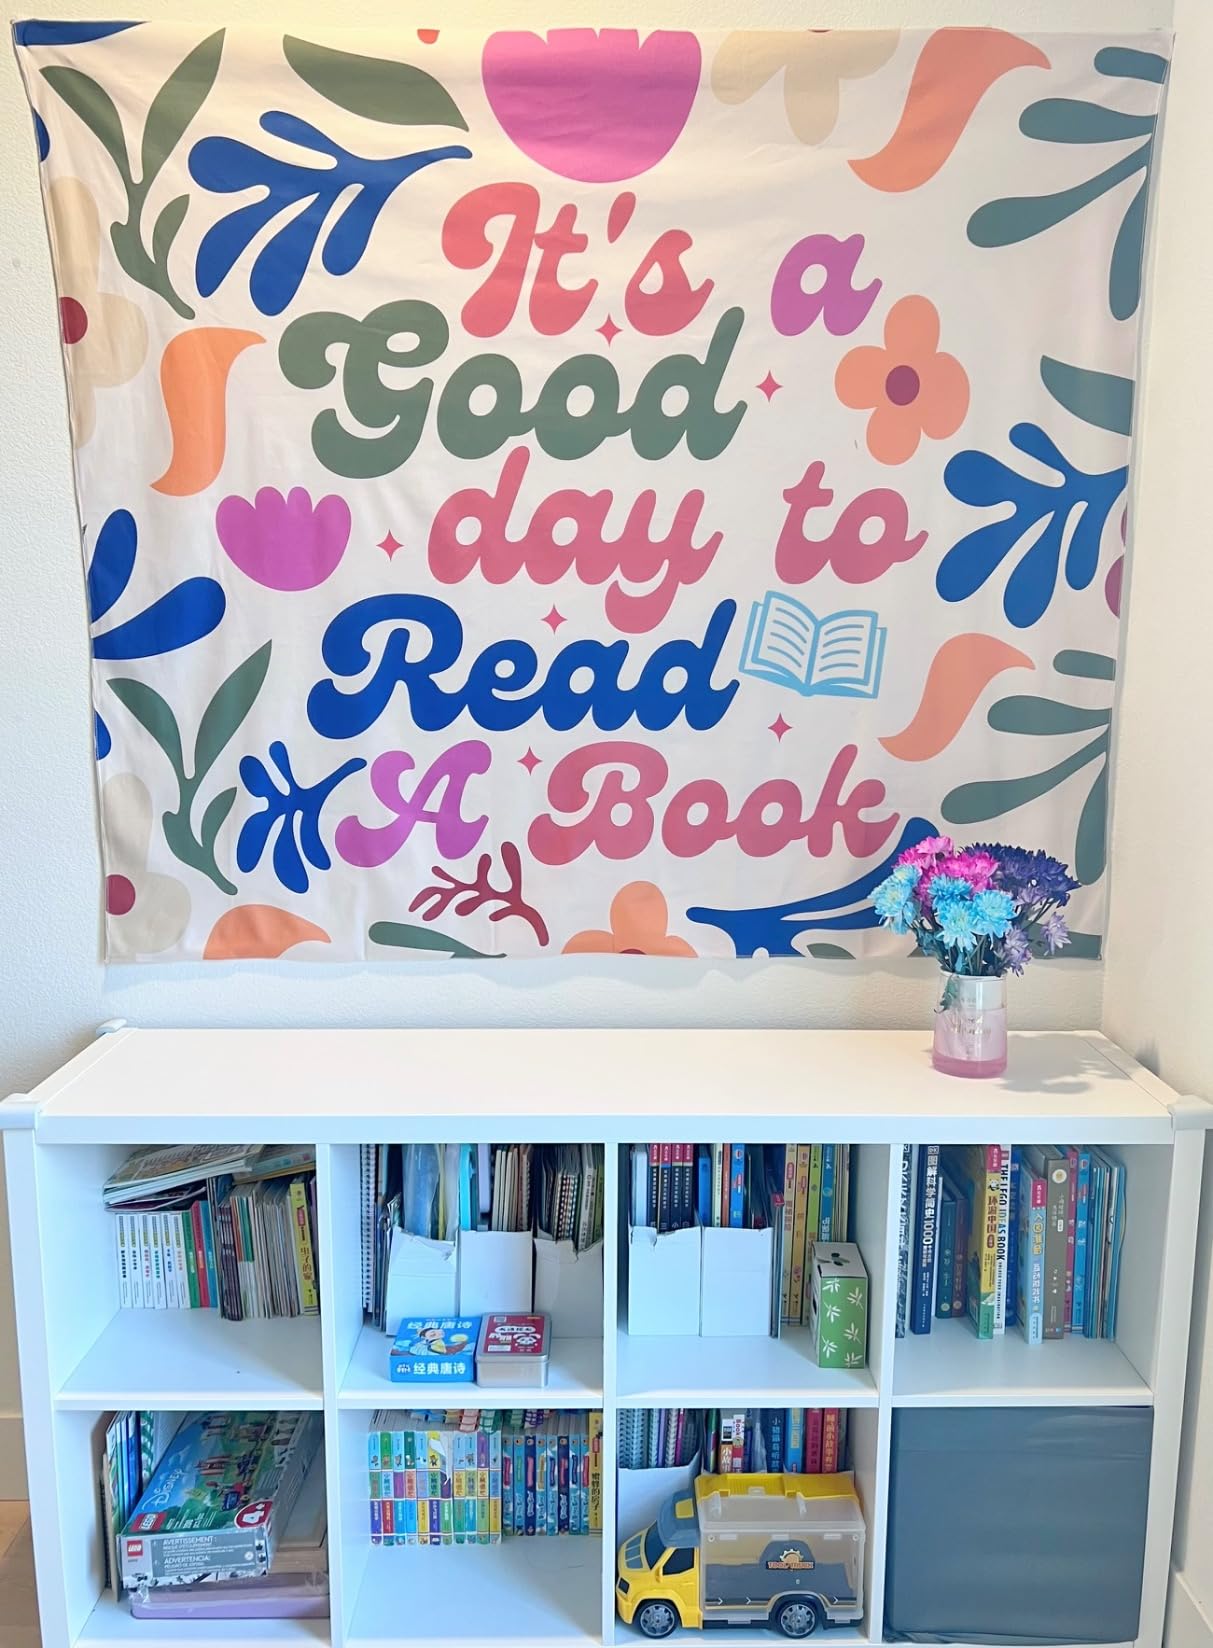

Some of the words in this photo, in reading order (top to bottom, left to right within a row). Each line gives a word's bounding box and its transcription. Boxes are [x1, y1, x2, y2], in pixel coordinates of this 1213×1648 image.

[441, 181, 715, 338] It's
[770, 233, 883, 337] a
[278, 298, 748, 480] Good
[427, 445, 724, 634] day
[774, 460, 930, 585] to
[306, 592, 741, 740] Read
[334, 739, 492, 869] A
[527, 740, 902, 867] Book
[1000, 1164, 1009, 1181] THE
[999, 1183, 1008, 1205] LEGO
[998, 1208, 1007, 1234] IDEAS
[996, 1236, 1007, 1261] BOOK
[406, 1320, 473, 1330] 经典唐诗
[413, 1361, 467, 1376] 经典唐诗
[127, 1544, 142, 1553] LEGO
[163, 1536, 213, 1546] AVERTISSEMENT
